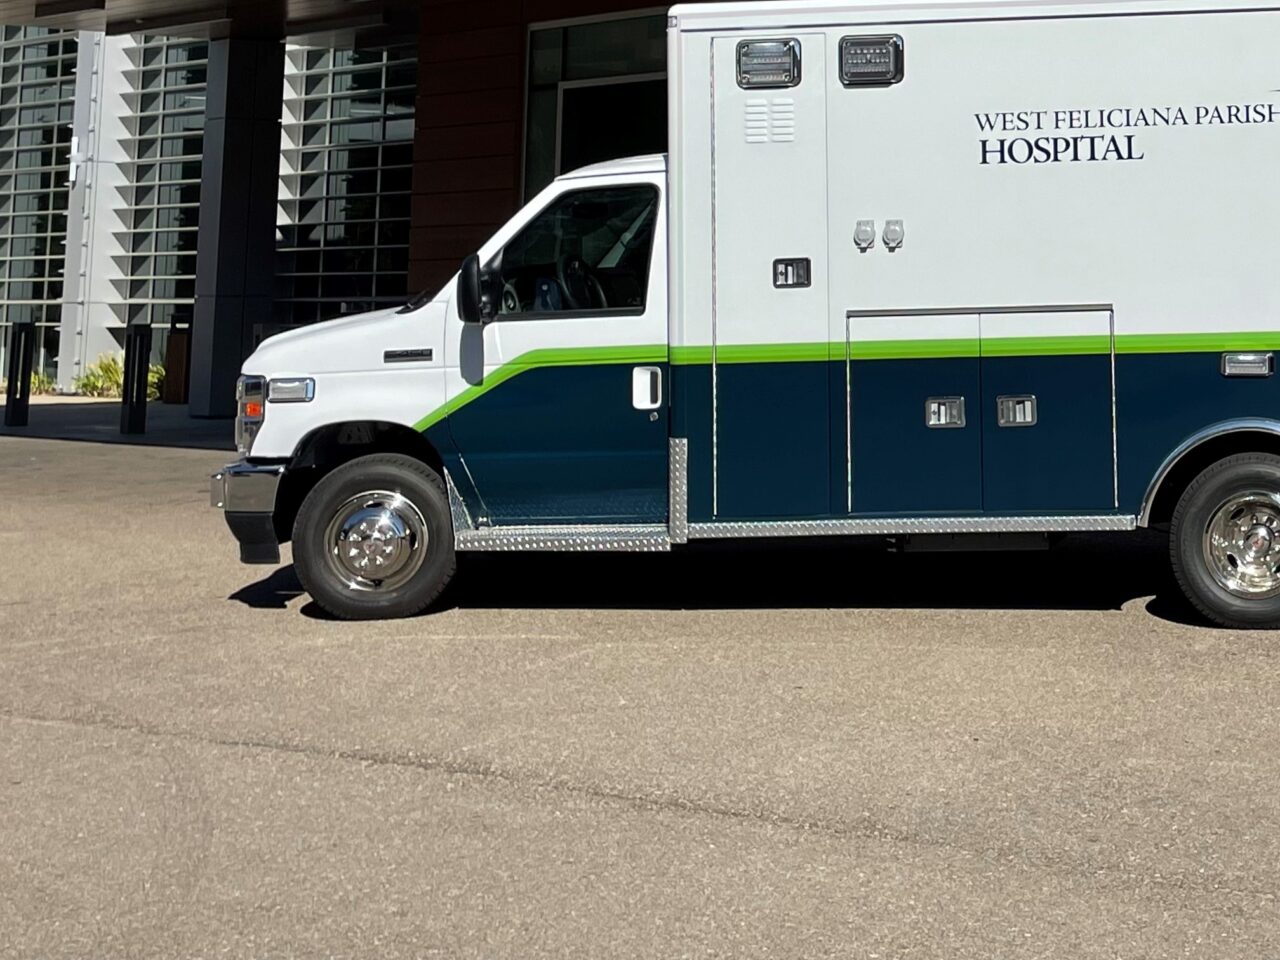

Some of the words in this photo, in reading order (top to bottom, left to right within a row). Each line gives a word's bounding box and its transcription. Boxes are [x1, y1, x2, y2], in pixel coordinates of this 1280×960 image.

[974, 110, 1047, 132] WEST
[1053, 106, 1189, 130] FELICIANA
[978, 134, 1144, 165] HOSPITAL
